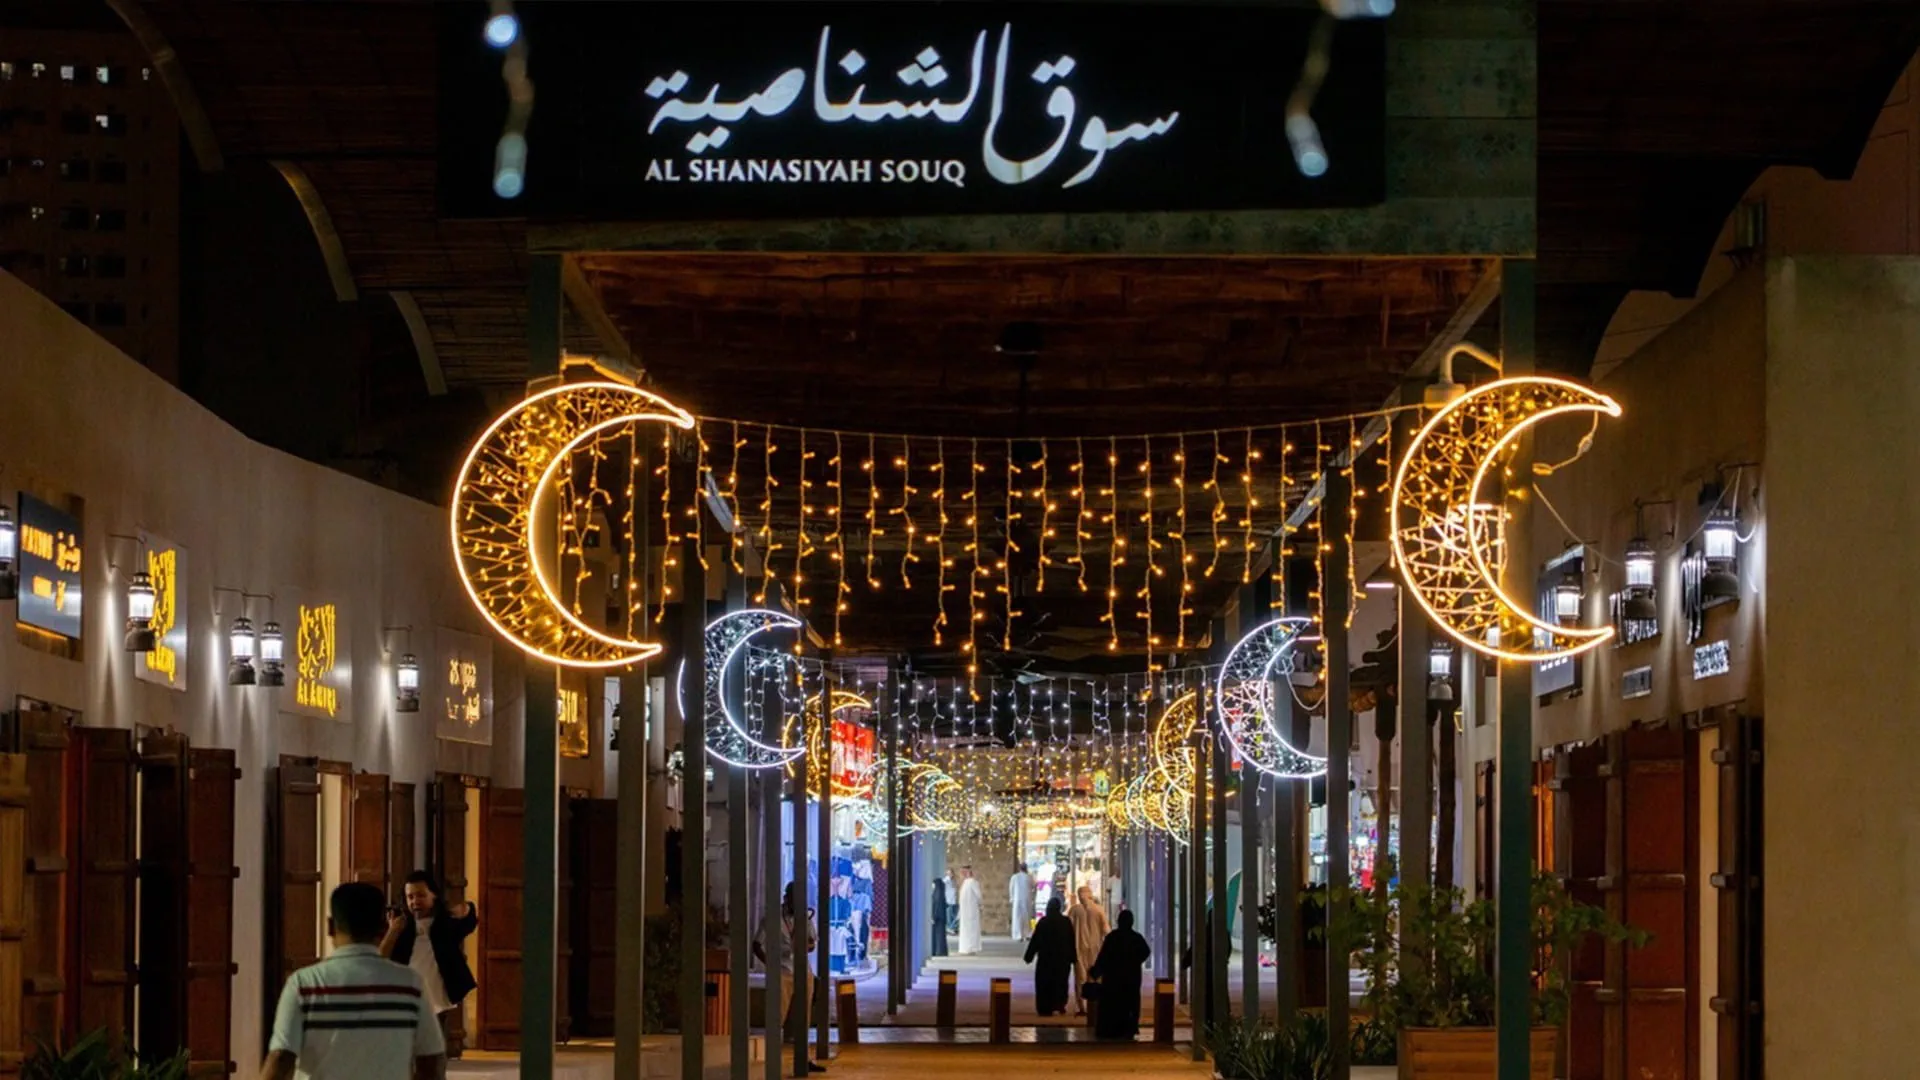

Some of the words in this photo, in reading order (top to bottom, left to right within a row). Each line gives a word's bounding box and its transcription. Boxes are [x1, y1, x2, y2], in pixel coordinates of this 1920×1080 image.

[644, 22, 1010, 154] الشناصية
[983, 22, 1180, 189] سوق
[645, 160, 681, 182] AL
[689, 159, 872, 182] SHANASIYAH
[881, 159, 966, 187] SOUQ
